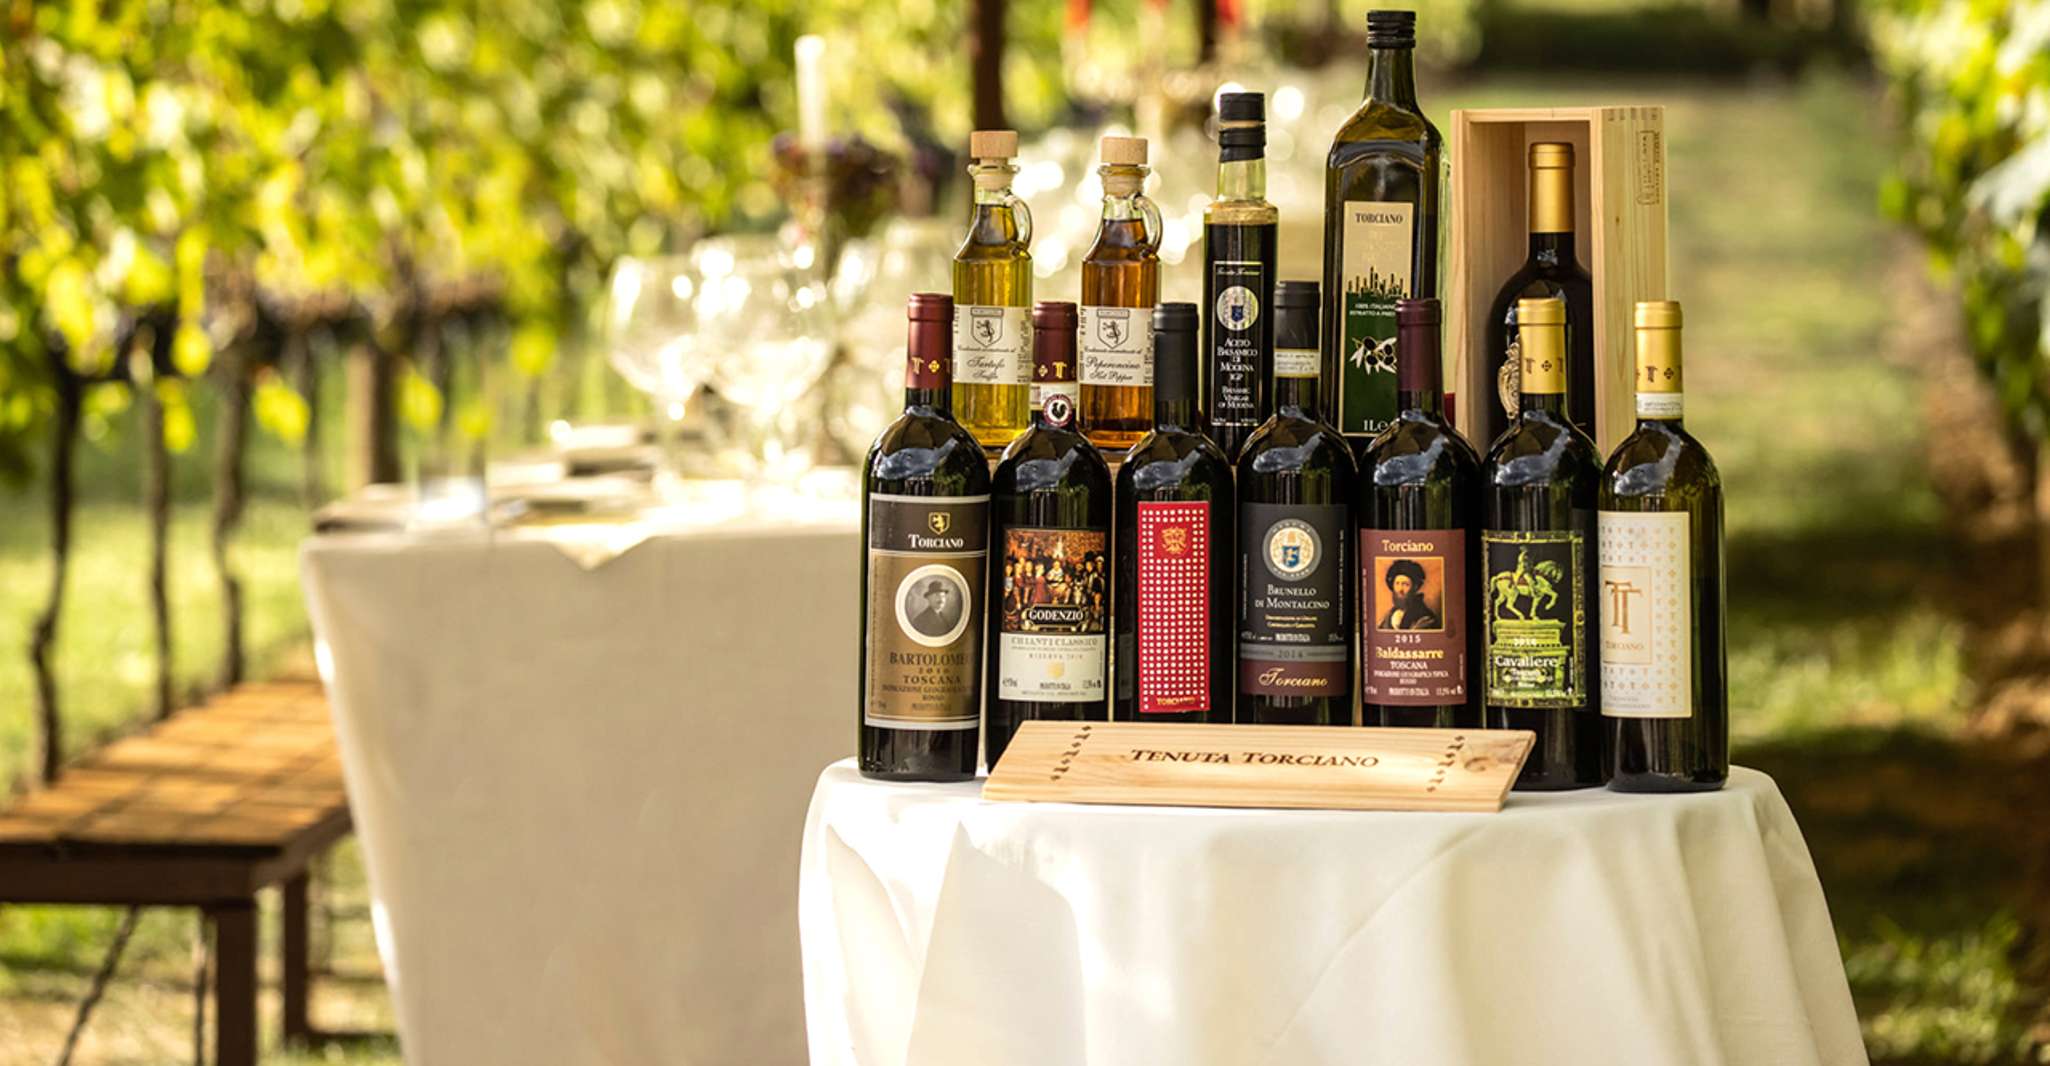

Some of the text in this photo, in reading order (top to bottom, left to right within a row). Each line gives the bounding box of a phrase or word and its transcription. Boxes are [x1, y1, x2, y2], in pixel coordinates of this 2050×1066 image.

[1355, 212, 1404, 224] TORCIANO
[1220, 361, 1255, 372] MODENA
[908, 534, 965, 548] TORCIANO
[1381, 539, 1434, 552] Torciano
[1267, 584, 1317, 596] BRUNELLO
[1255, 597, 1330, 609] DI MONTALCINO
[1029, 610, 1084, 621] GODENZIO
[1395, 634, 1422, 643] 2015
[1376, 646, 1444, 659] Baldassarre
[1389, 660, 1428, 670] TOSCANA
[1496, 655, 1559, 667] Cavaliere
[903, 675, 962, 685] TOSCANA
[1258, 667, 1328, 687] Torciano
[1131, 749, 1380, 767] TENUTA TORCIANO
